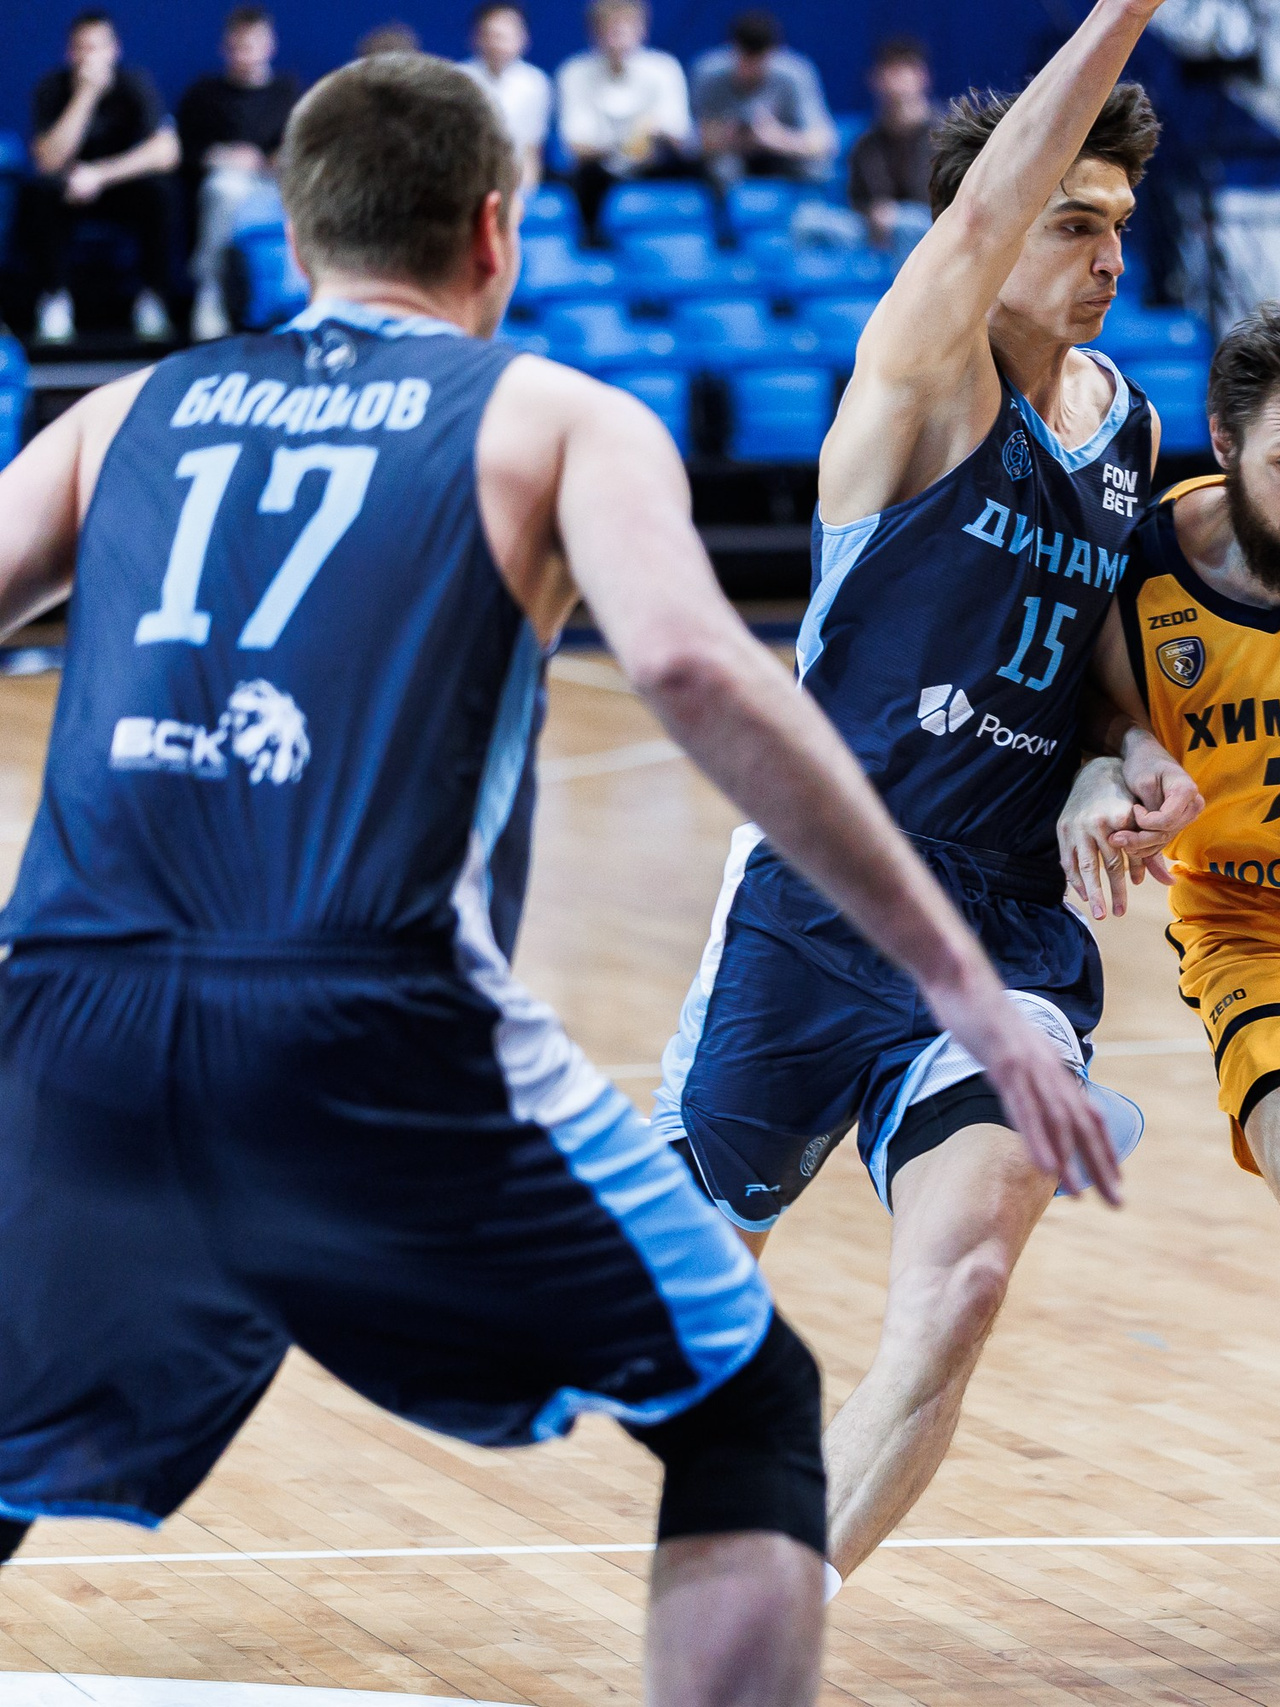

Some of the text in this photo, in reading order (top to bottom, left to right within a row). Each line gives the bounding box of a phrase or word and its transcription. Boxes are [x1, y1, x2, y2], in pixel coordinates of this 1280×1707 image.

[170, 372, 431, 435] БАЛАШОВ
[1102, 462, 1139, 493] FON
[1102, 487, 1139, 518] BET
[134, 442, 378, 650] 17
[1147, 608, 1198, 630] ZEDO
[996, 596, 1078, 691] 15
[1208, 987, 1247, 1025] ZEDO
